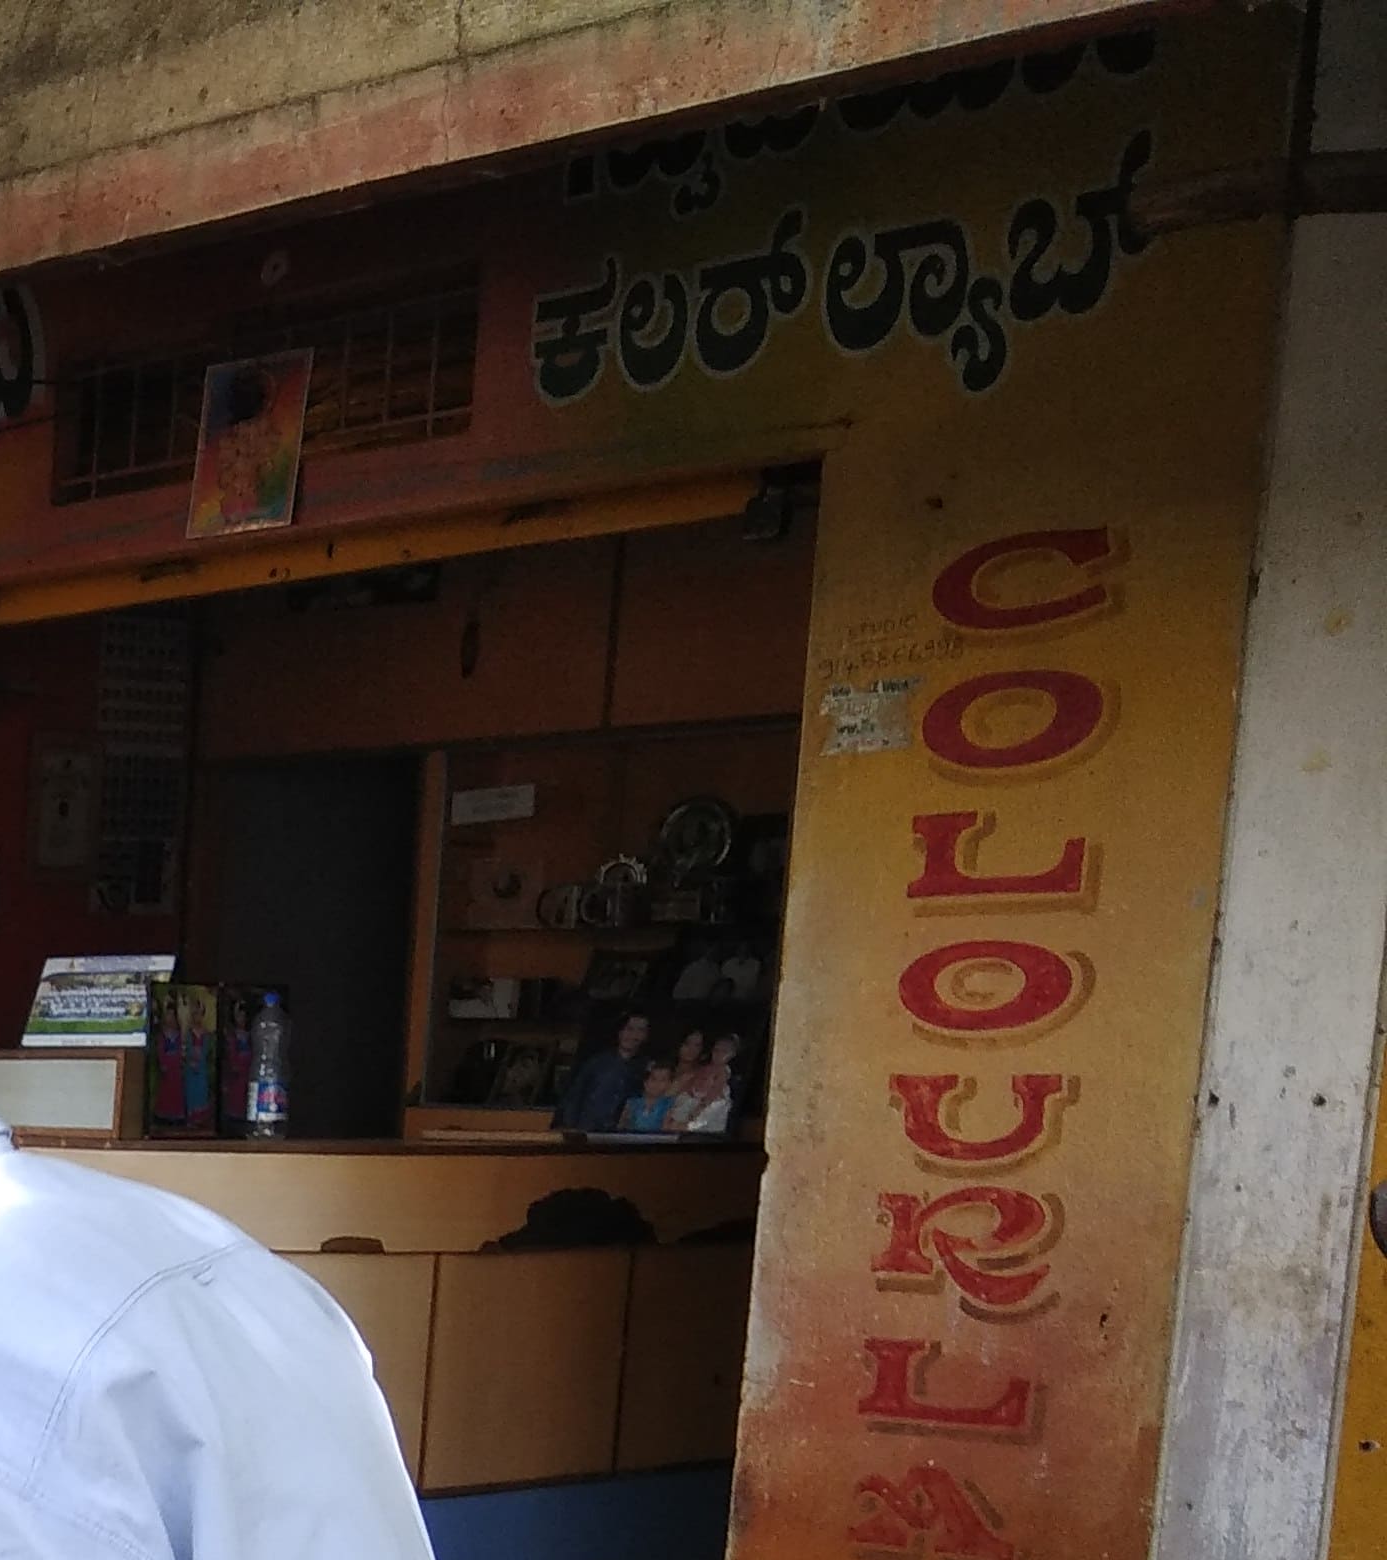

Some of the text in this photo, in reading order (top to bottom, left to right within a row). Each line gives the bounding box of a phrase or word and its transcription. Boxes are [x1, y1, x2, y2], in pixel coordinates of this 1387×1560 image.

[535, 211, 807, 399] ಕಲರ್
[826, 128, 1154, 392] ಲ್ಯಾಬ್
[871, 525, 1113, 1306] COLOUR
